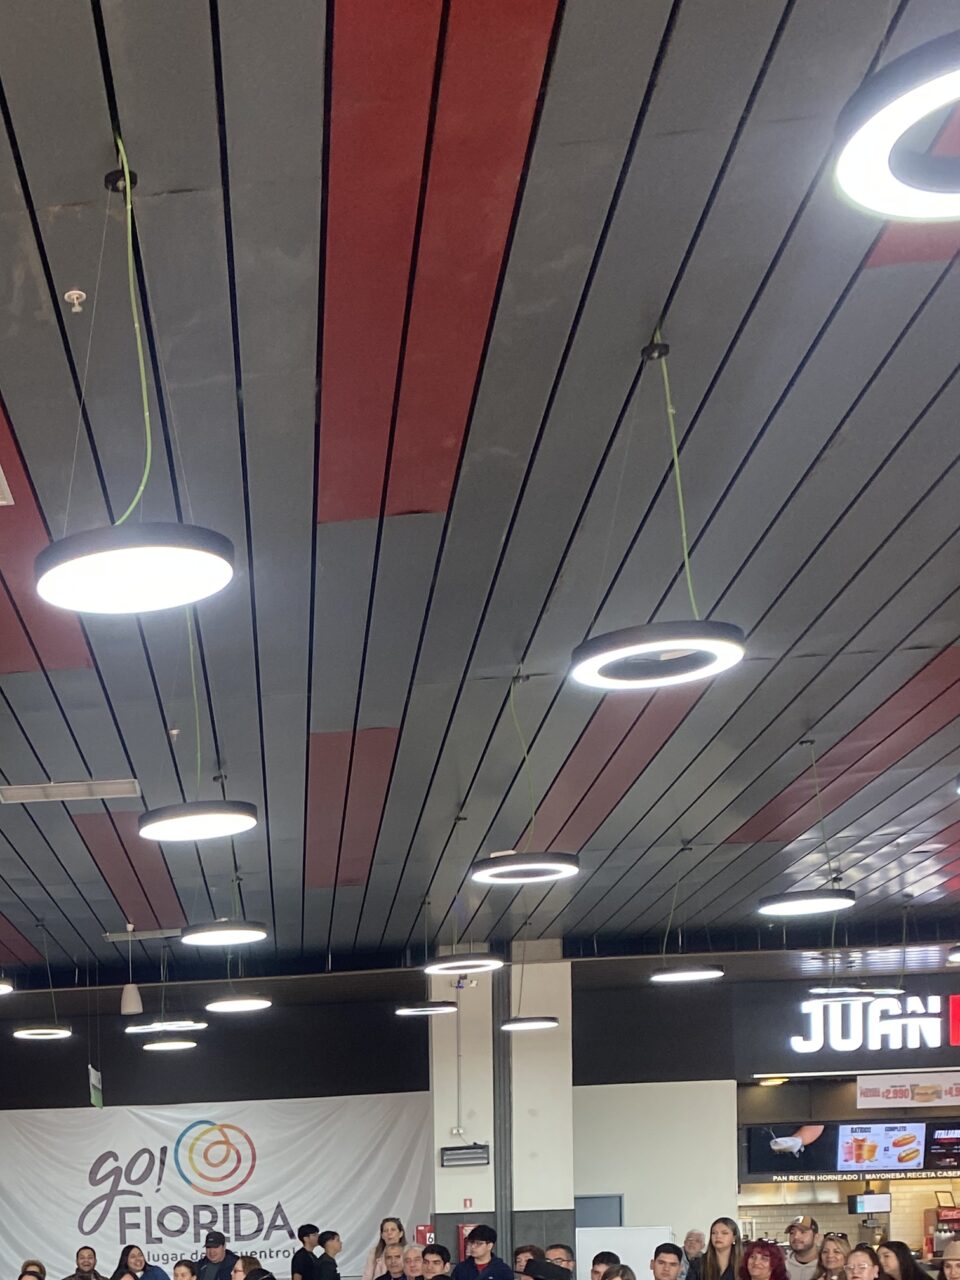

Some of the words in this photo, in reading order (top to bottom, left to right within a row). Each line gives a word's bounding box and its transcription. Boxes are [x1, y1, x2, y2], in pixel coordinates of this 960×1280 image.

[791, 996, 941, 1053] JUAN
[788, 1174, 816, 1182] RECIEN
[816, 1173, 858, 1182] HORNEADO
[865, 1172, 906, 1180] MAYONESA
[906, 1171, 937, 1179] RECETA
[119, 1201, 297, 1245] FLORIDA
[427, 1233, 435, 1244] 6
[146, 1251, 186, 1264] lugar
